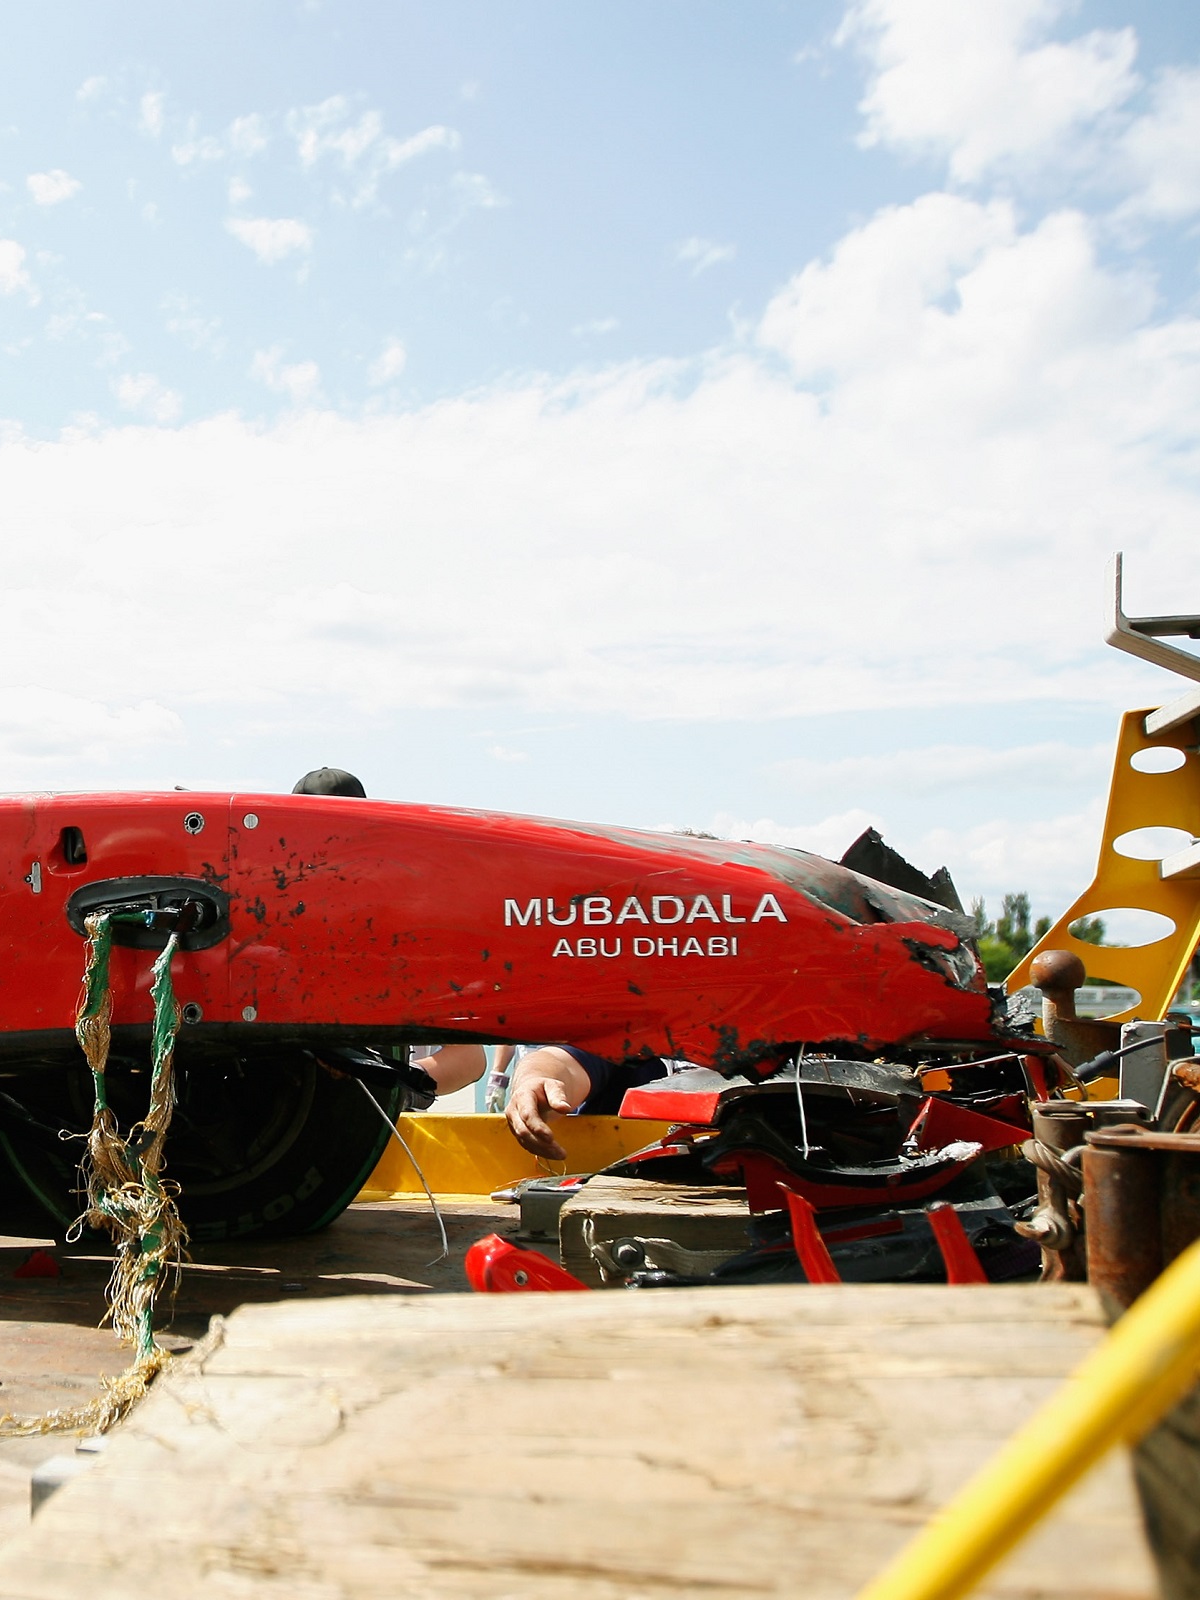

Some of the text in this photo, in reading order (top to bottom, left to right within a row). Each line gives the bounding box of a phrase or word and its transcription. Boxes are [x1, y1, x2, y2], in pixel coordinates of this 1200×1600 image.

[504, 893, 788, 927] MUBADALA
[552, 936, 738, 958] ABU DHABI
